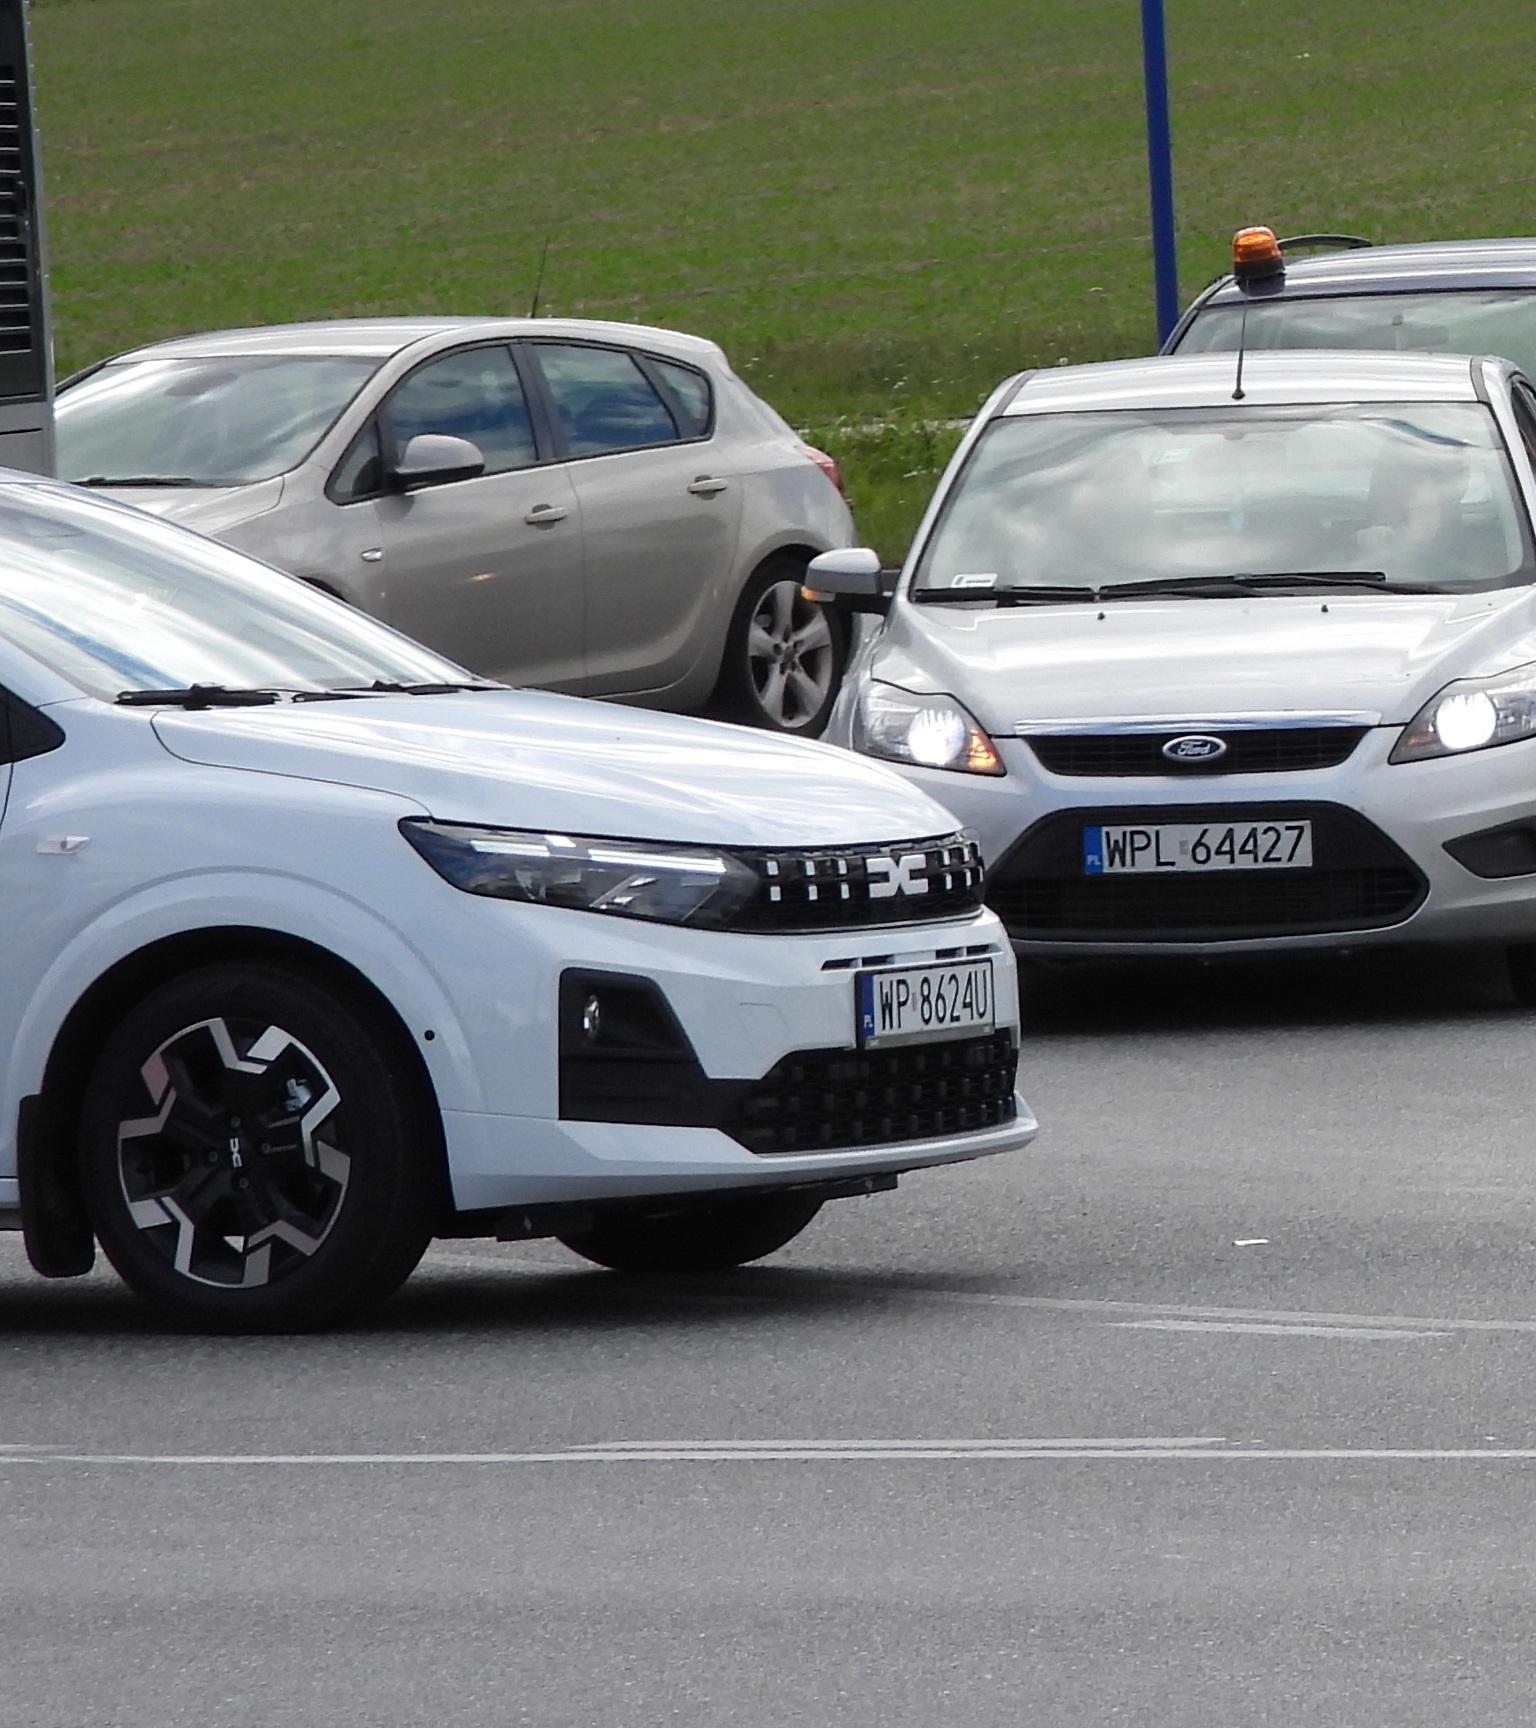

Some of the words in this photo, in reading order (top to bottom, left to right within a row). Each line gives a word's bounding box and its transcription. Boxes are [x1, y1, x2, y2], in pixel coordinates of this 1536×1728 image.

[1176, 740, 1211, 756] Ford
[1105, 829, 1176, 868] WPL
[1191, 825, 1304, 865] 64427
[879, 979, 910, 1031] WP
[920, 969, 989, 1026] 8624U
